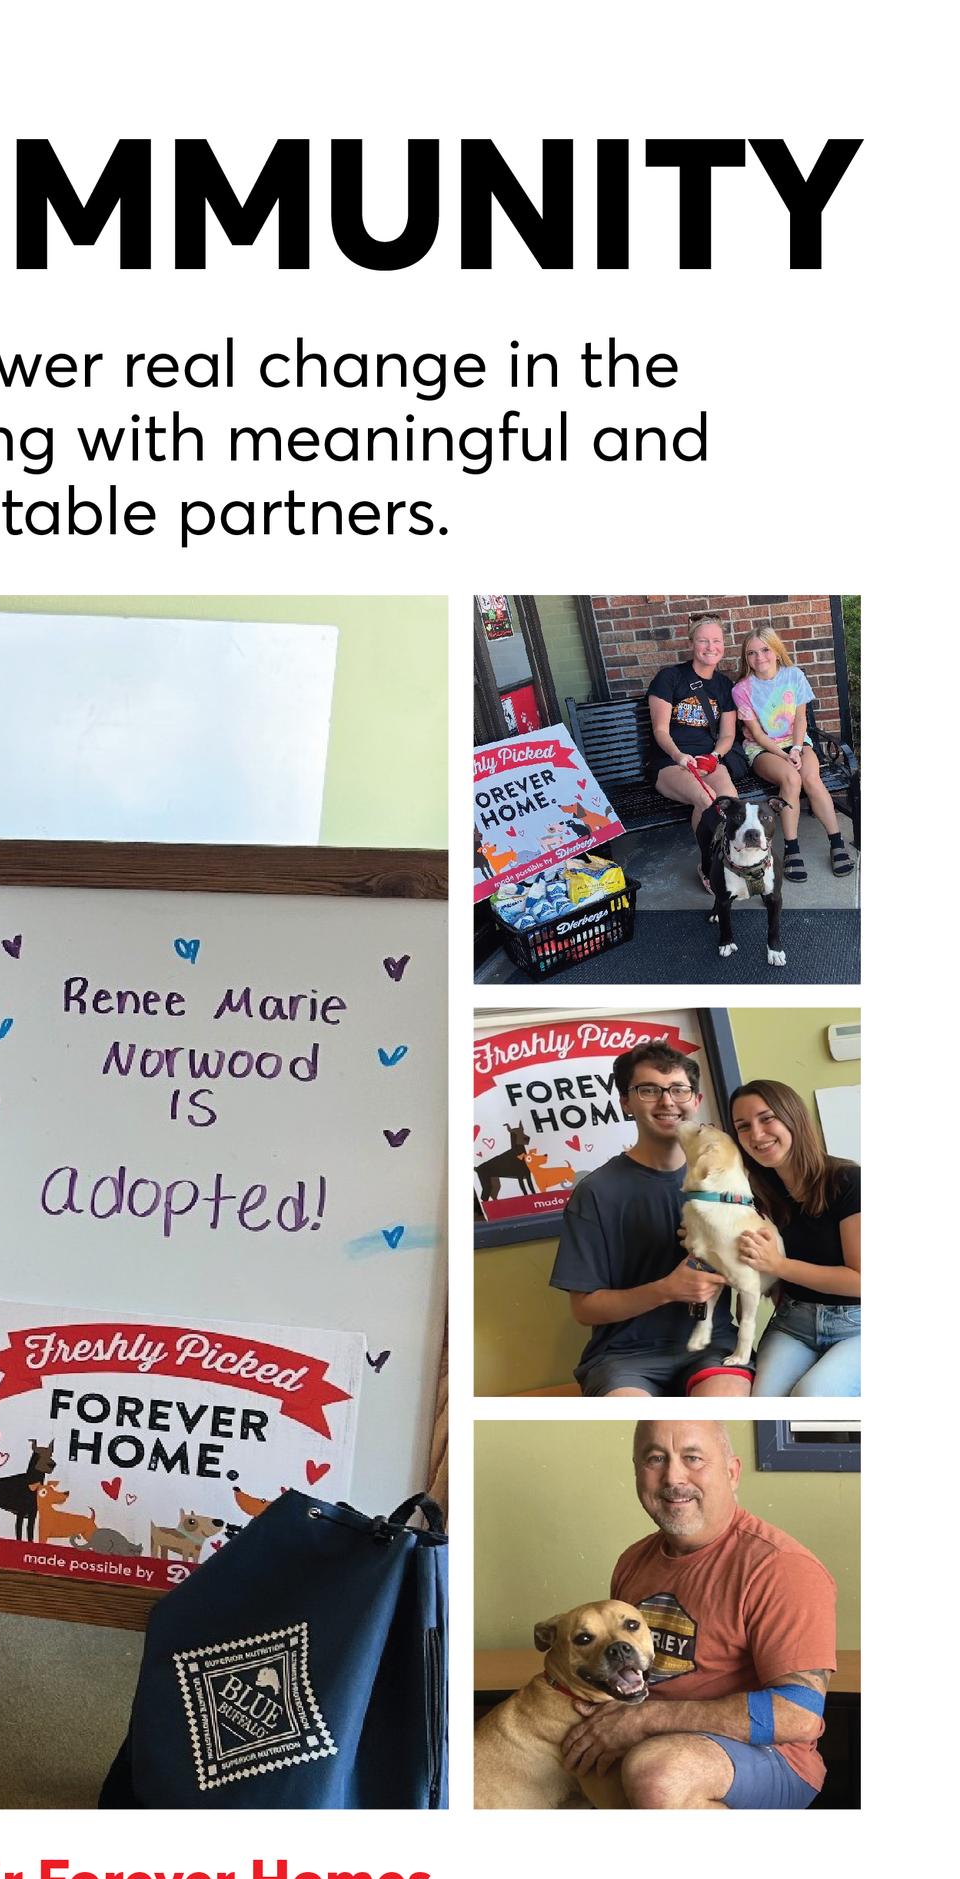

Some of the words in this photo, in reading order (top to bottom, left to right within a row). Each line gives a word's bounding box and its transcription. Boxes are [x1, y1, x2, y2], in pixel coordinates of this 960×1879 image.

[498, 744, 556, 766] Picked
[475, 769, 556, 809] OREVER
[480, 791, 557, 830] HOME.
[555, 836, 597, 860] Dierbergs
[556, 909, 609, 935] Dierbergs
[63, 977, 187, 1019] Renee
[213, 986, 348, 1026] Marie
[102, 1041, 320, 1082] Norwood
[474, 1030, 575, 1074] Freshly
[534, 1197, 564, 1209] made
[24, 1331, 168, 1372] Freshly
[175, 1333, 310, 1392] Picked
[50, 1389, 269, 1442] FOREVER
[68, 1428, 240, 1481] HOME.
[23, 1553, 66, 1567] made
[69, 1560, 132, 1577] possible
[136, 1564, 155, 1582] by
[217, 1701, 269, 1739] BUFFALO
[218, 1673, 284, 1729] BLUE
